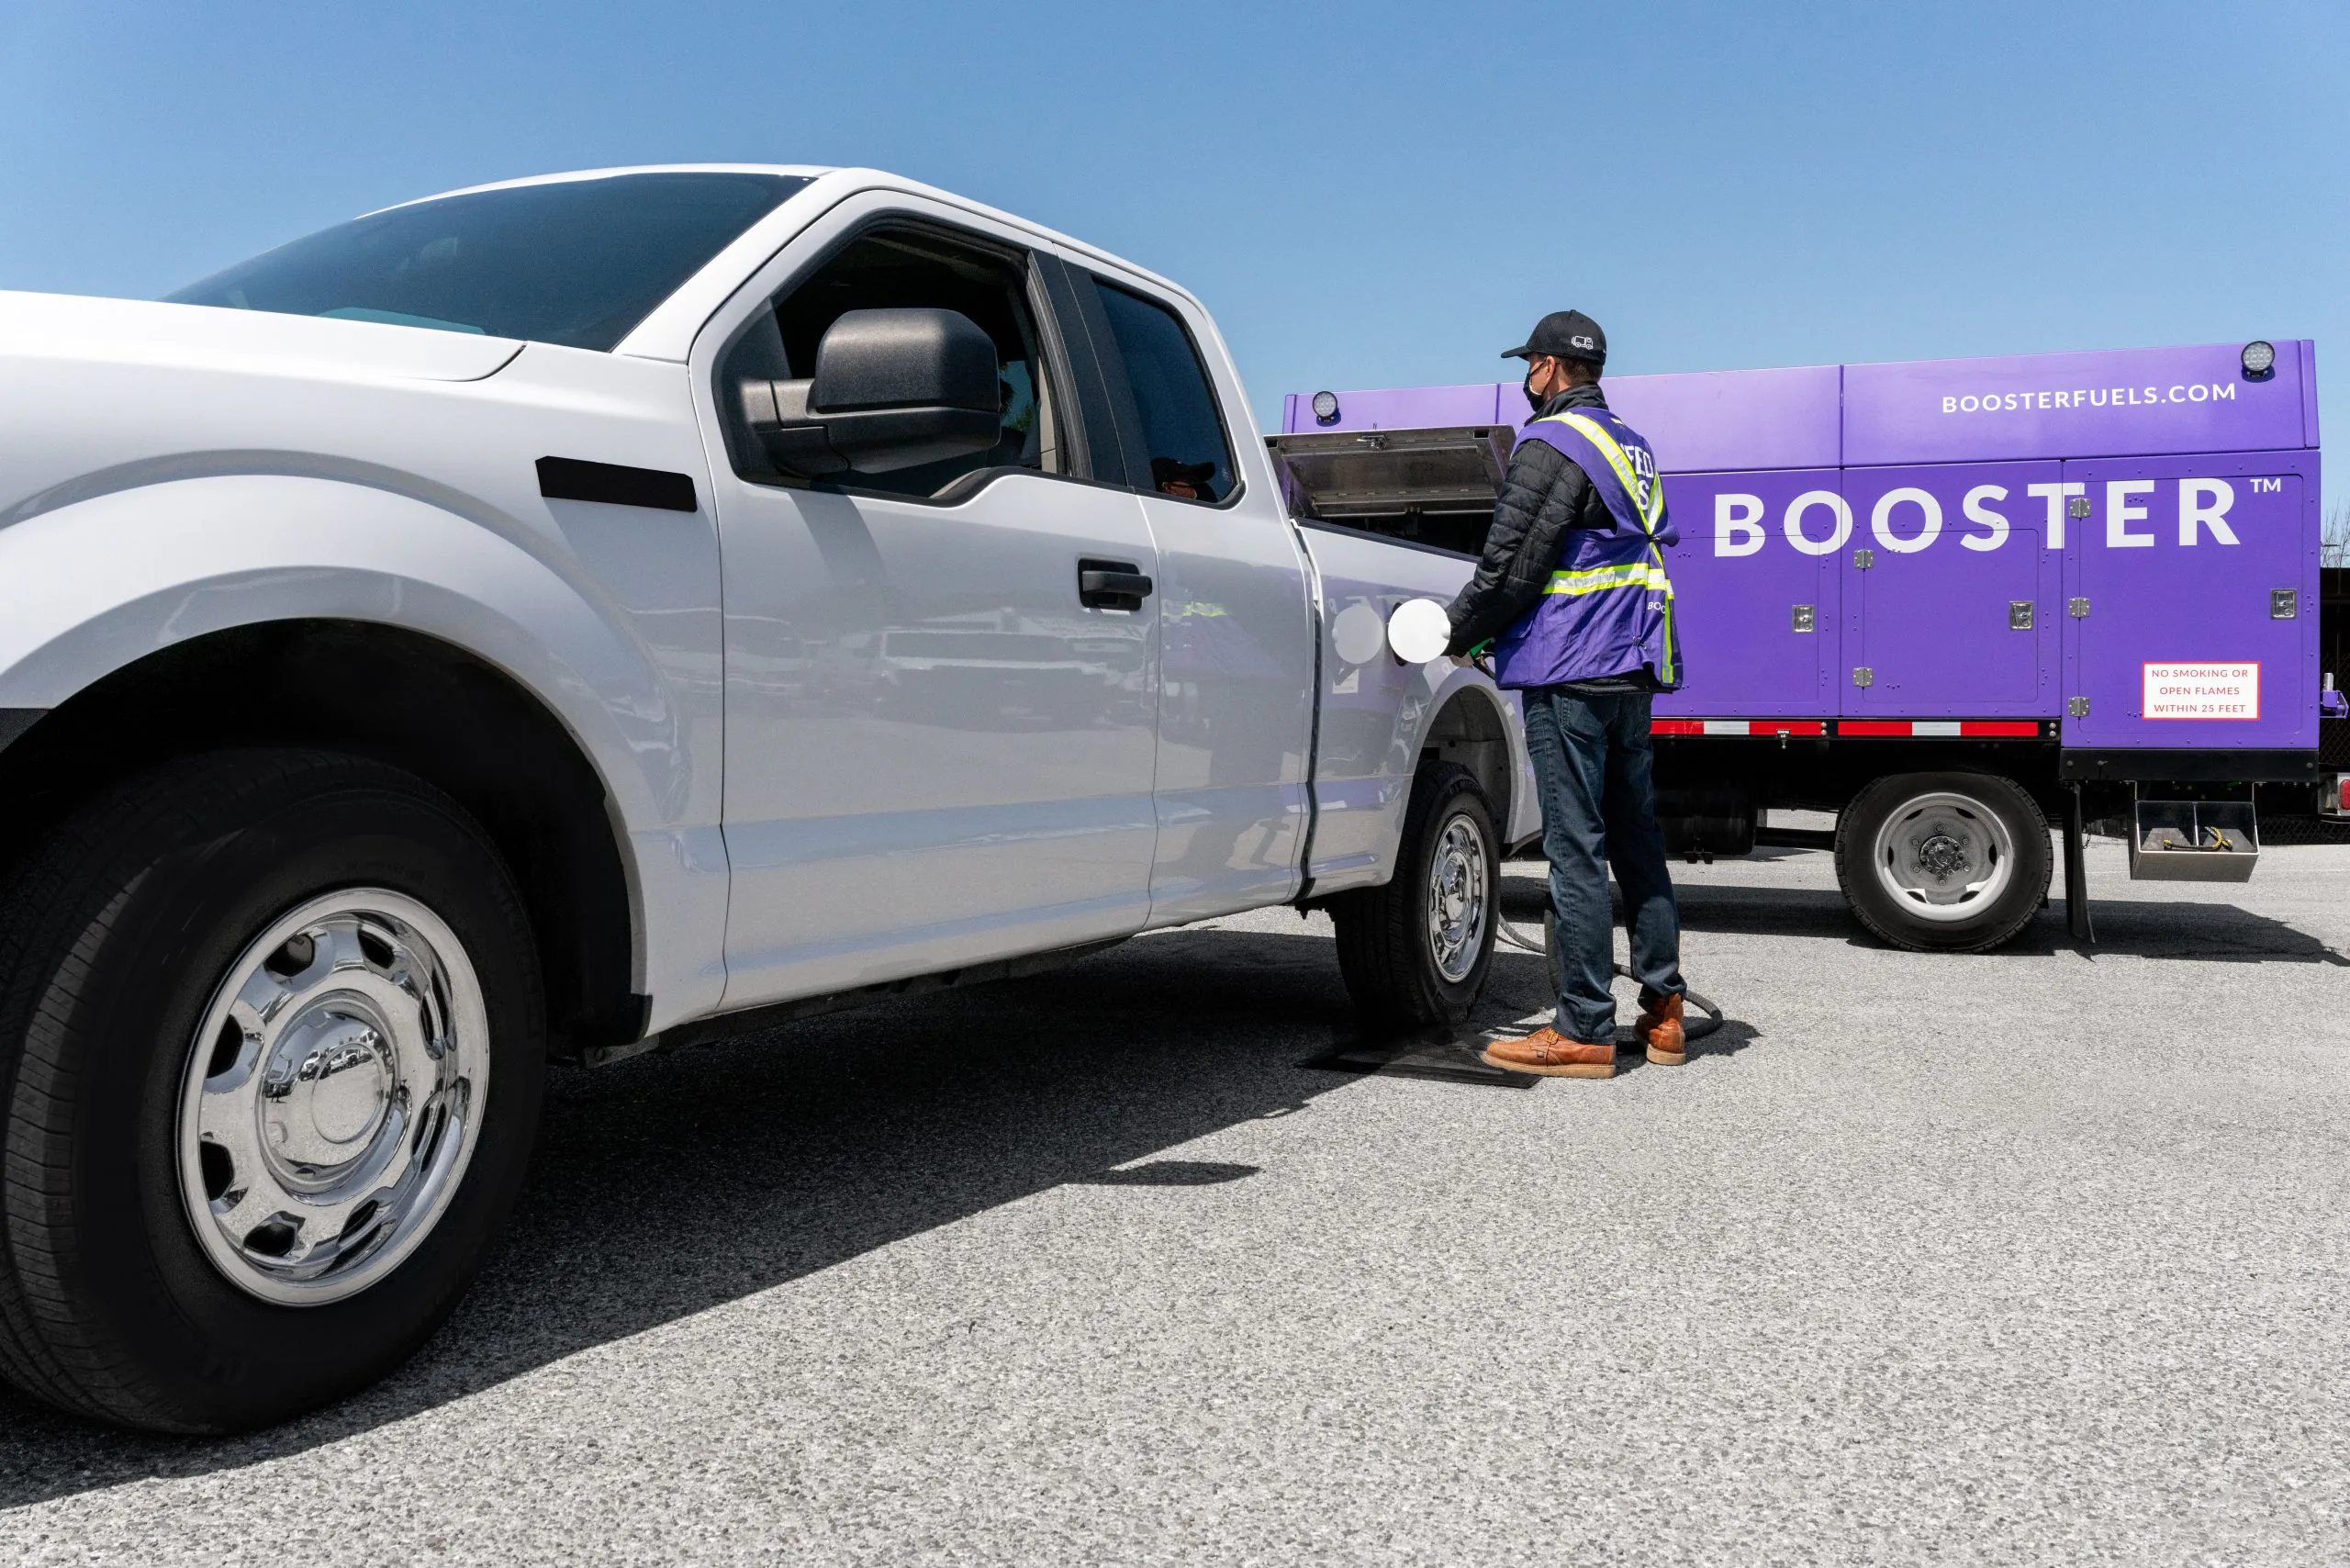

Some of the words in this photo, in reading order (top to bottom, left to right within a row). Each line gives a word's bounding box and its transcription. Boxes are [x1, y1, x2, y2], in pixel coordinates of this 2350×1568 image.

[1942, 383, 2236, 413] BOOSTERFUELS.COM
[1714, 477, 2241, 557] BOOSTER
[2152, 669, 2169, 678] NO
[2173, 669, 2228, 678] SMOKING
[2232, 669, 2248, 678] OR
[2159, 687, 2191, 695] OPEN
[2195, 687, 2240, 695] FLAMES
[2154, 704, 2198, 712] WITHIN
[2201, 704, 2214, 712] 25
[2218, 704, 2245, 712] FEET
